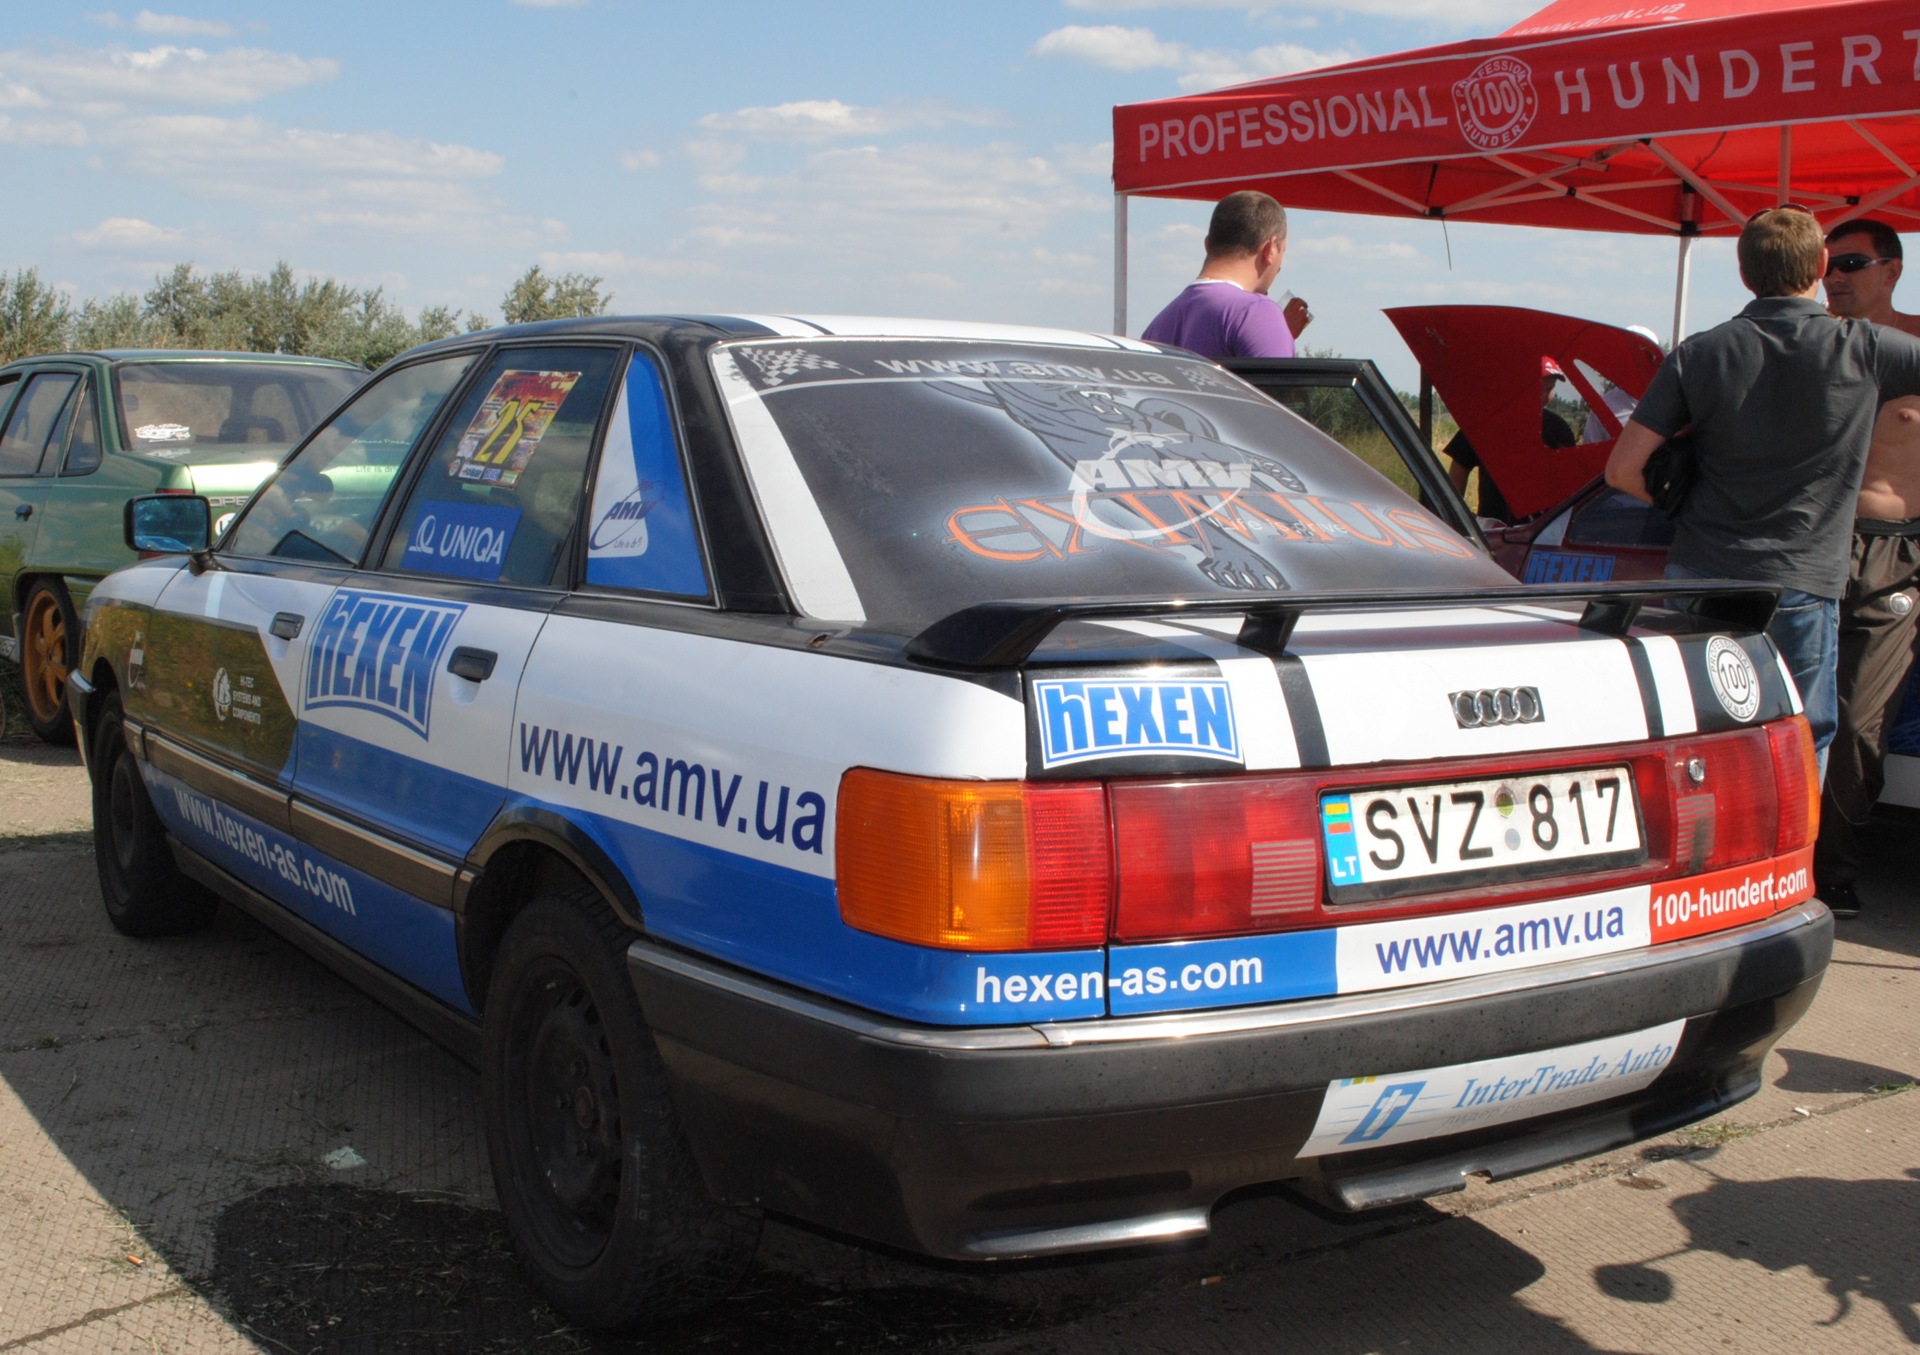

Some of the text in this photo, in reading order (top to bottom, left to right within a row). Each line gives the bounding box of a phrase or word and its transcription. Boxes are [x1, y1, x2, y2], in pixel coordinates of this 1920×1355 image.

[1471, 79, 1518, 117] 100
[1138, 85, 1448, 163] PROFESSIONAL
[1463, 112, 1530, 147] HUNDERT
[874, 358, 1176, 386] www.amv.ua
[473, 397, 545, 465] 25
[1067, 459, 1252, 491] AMV
[439, 523, 505, 565] UNIQA
[1709, 638, 1751, 673] PROFESSIONAL
[1720, 663, 1747, 690] 100
[1719, 691, 1757, 716] HUNDERT
[520, 722, 826, 855] www.amv.ua
[1365, 776, 1621, 871] SVZ 817
[174, 787, 357, 917] www.hexen-as.com
[1332, 855, 1358, 879] LT
[1652, 866, 1808, 928] 100-hundert.com
[1375, 905, 1625, 975] www.amv.ua
[976, 956, 1263, 1004] hexen-as.com
[1452, 1053, 1606, 1109] InterTrade
[1606, 1043, 1673, 1079] Auto
